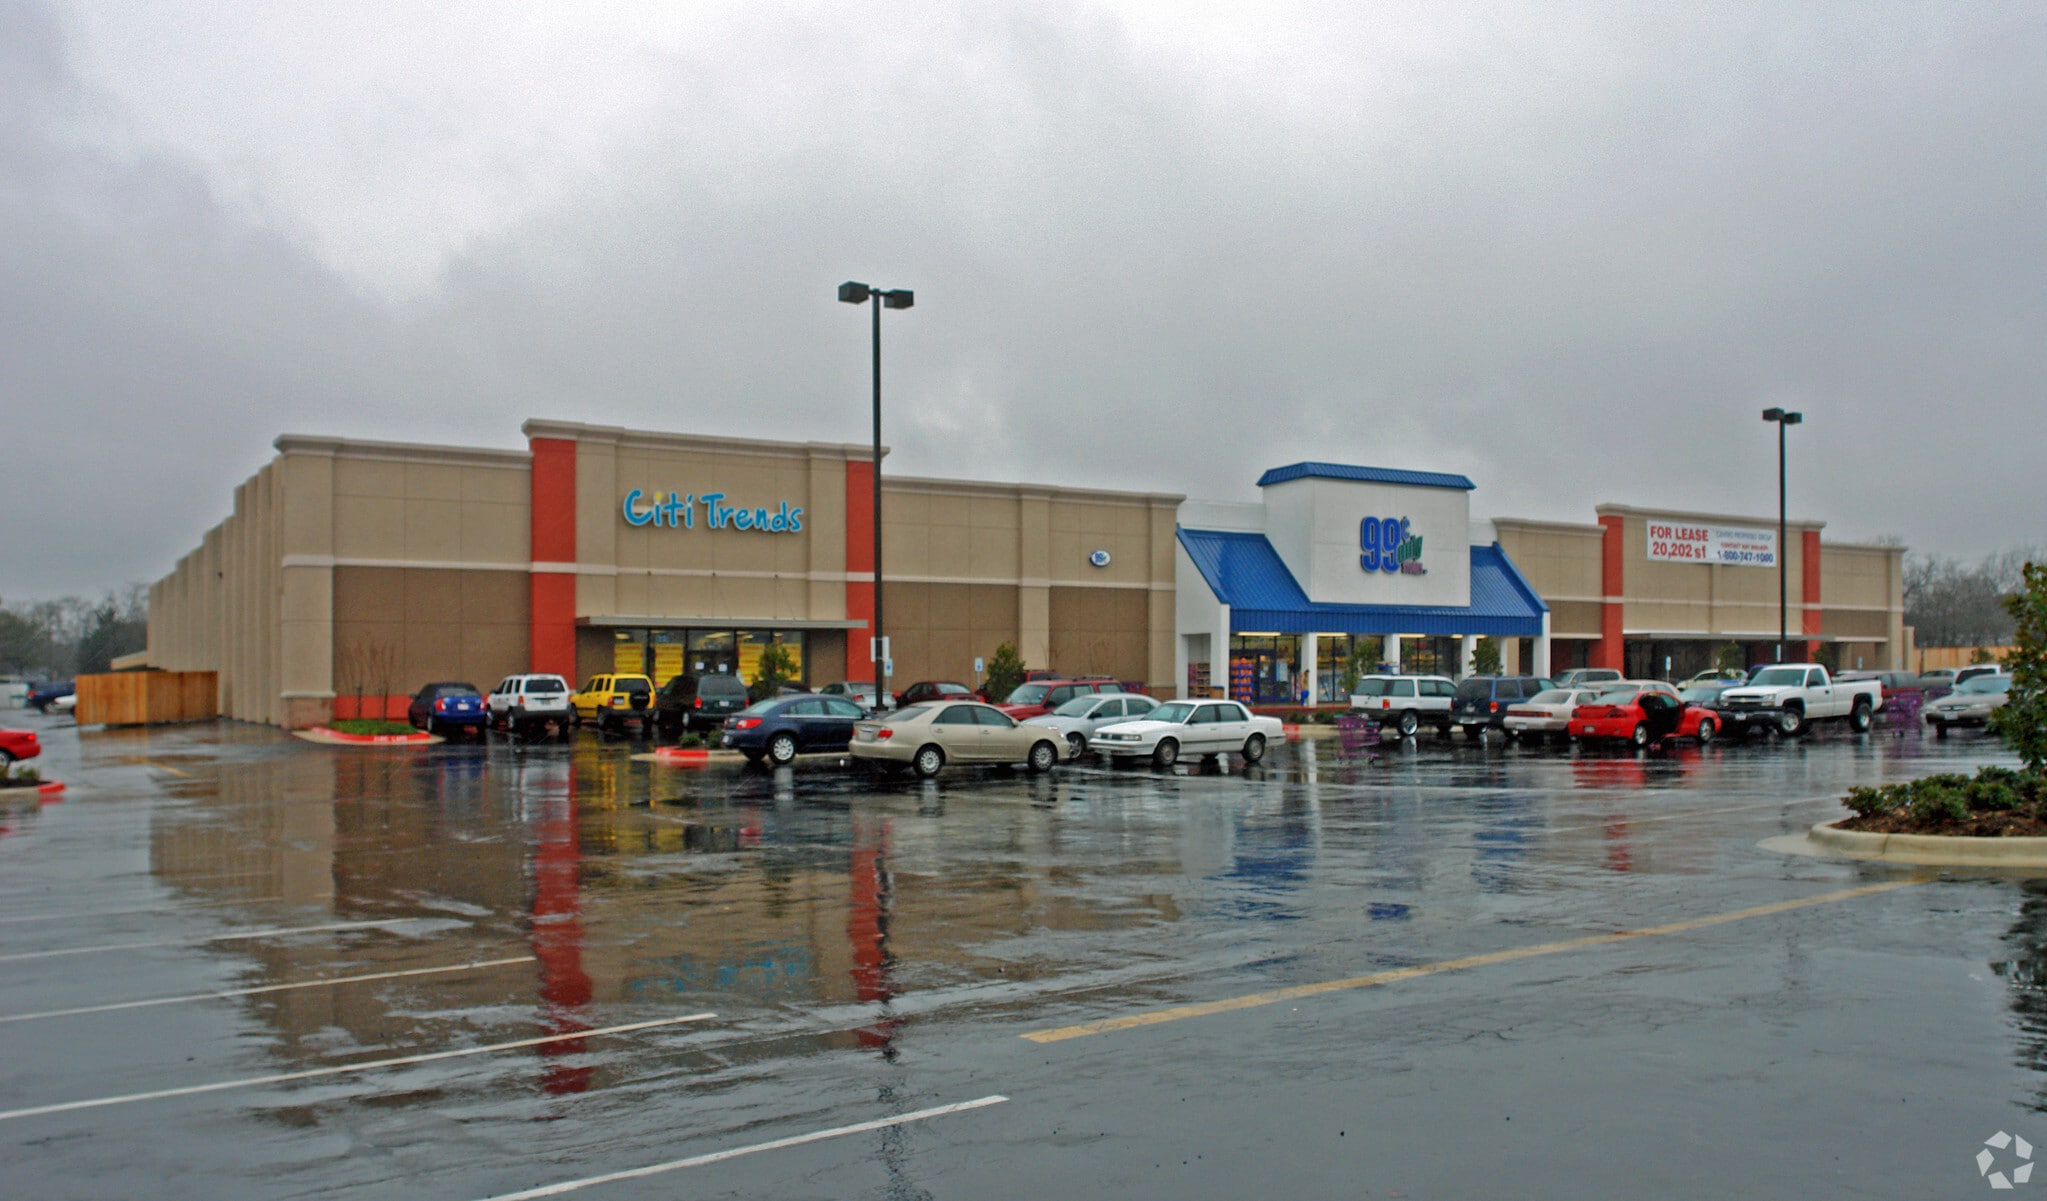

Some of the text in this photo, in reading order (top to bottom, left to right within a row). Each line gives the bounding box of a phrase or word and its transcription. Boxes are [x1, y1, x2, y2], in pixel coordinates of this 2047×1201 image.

[623, 488, 803, 532] Citi Trends
[1650, 525, 1672, 539] FOR
[1675, 527, 1709, 542] LEASE
[1652, 541, 1693, 559] 20,202
